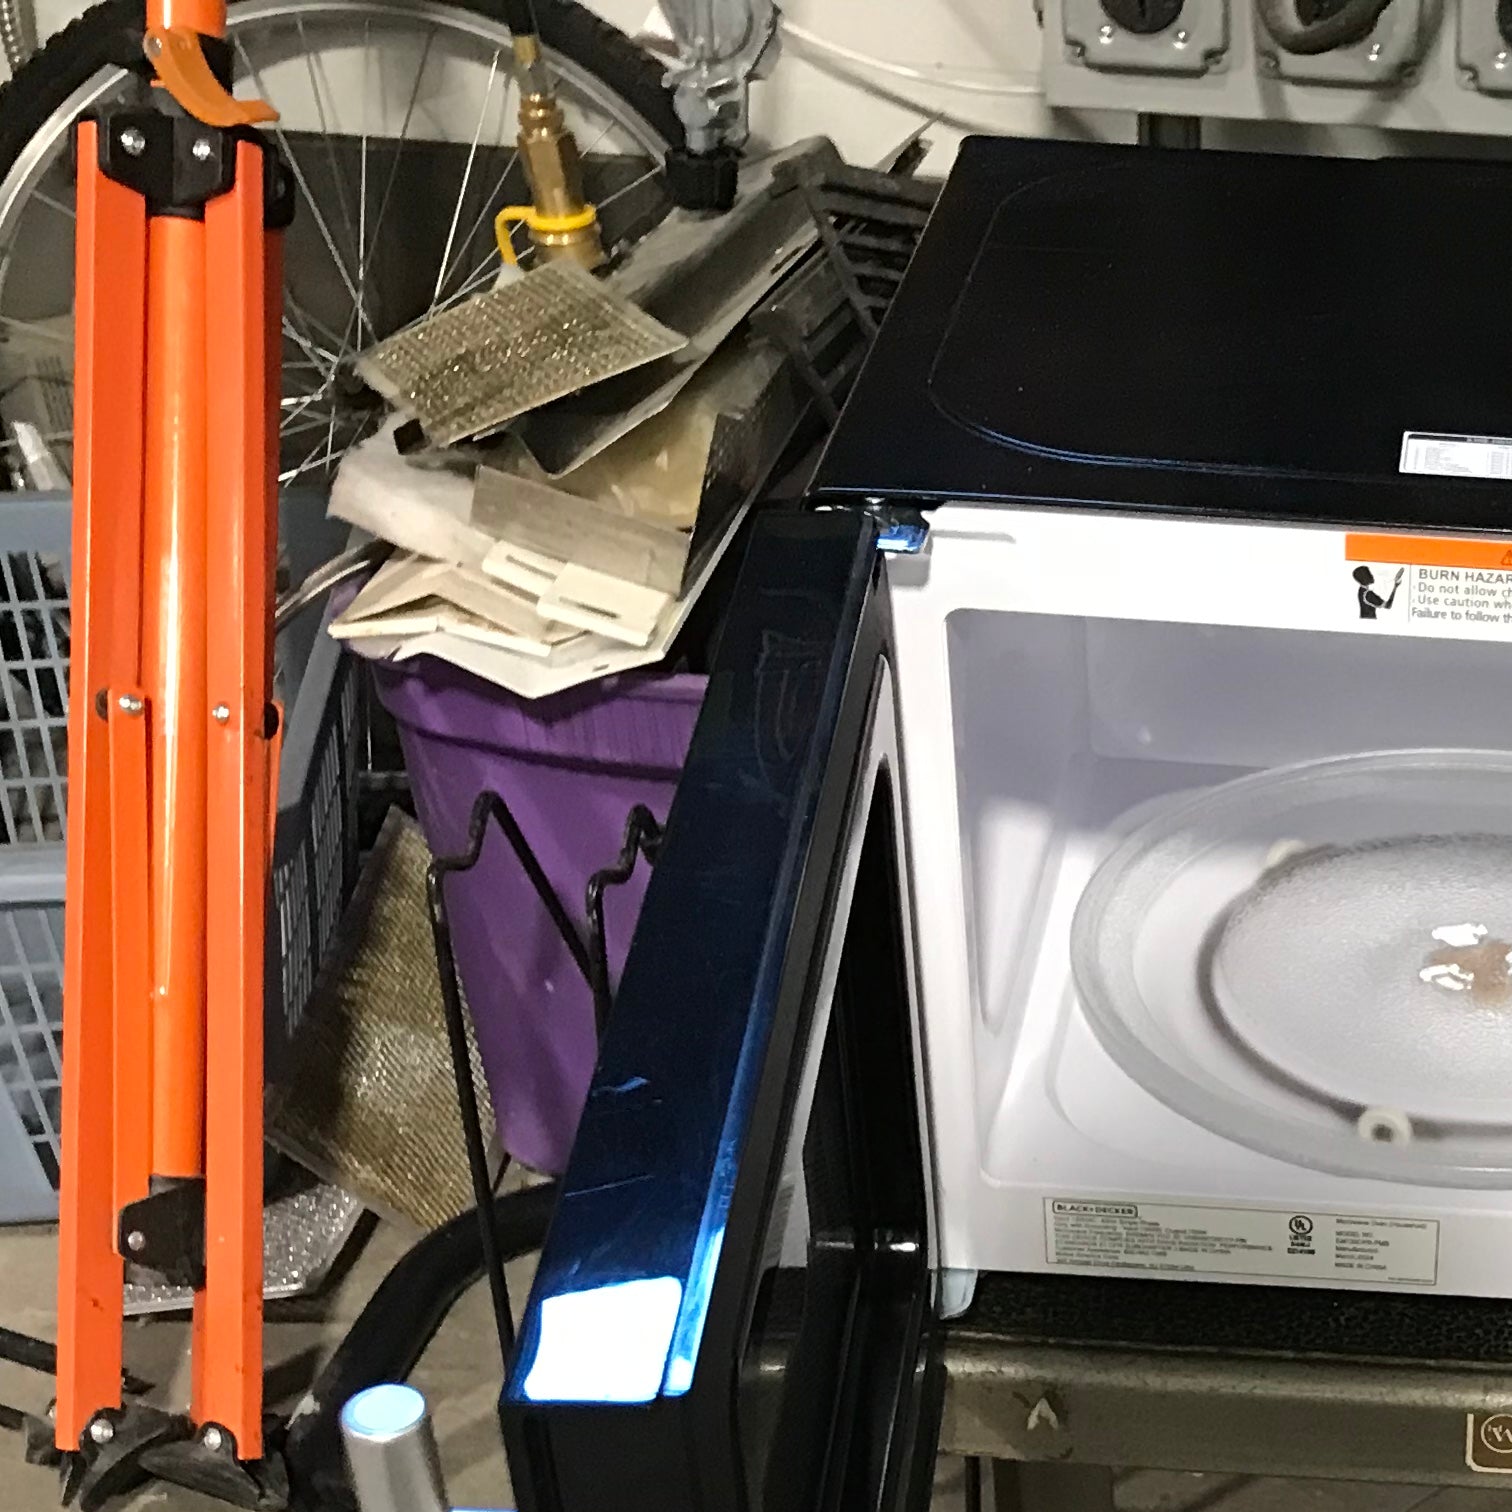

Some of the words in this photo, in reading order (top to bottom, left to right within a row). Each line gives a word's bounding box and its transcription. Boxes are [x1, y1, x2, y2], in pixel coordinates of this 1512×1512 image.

[1418, 568, 1460, 581] BURN
[1418, 582, 1435, 593] Do
[1439, 584, 1460, 594] not
[1464, 584, 1498, 597] allow
[1418, 595, 1440, 606] Use
[1444, 596, 1490, 609] caution
[1411, 607, 1448, 620] Failure
[1451, 610, 1463, 621] to
[1465, 609, 1500, 623] follow
